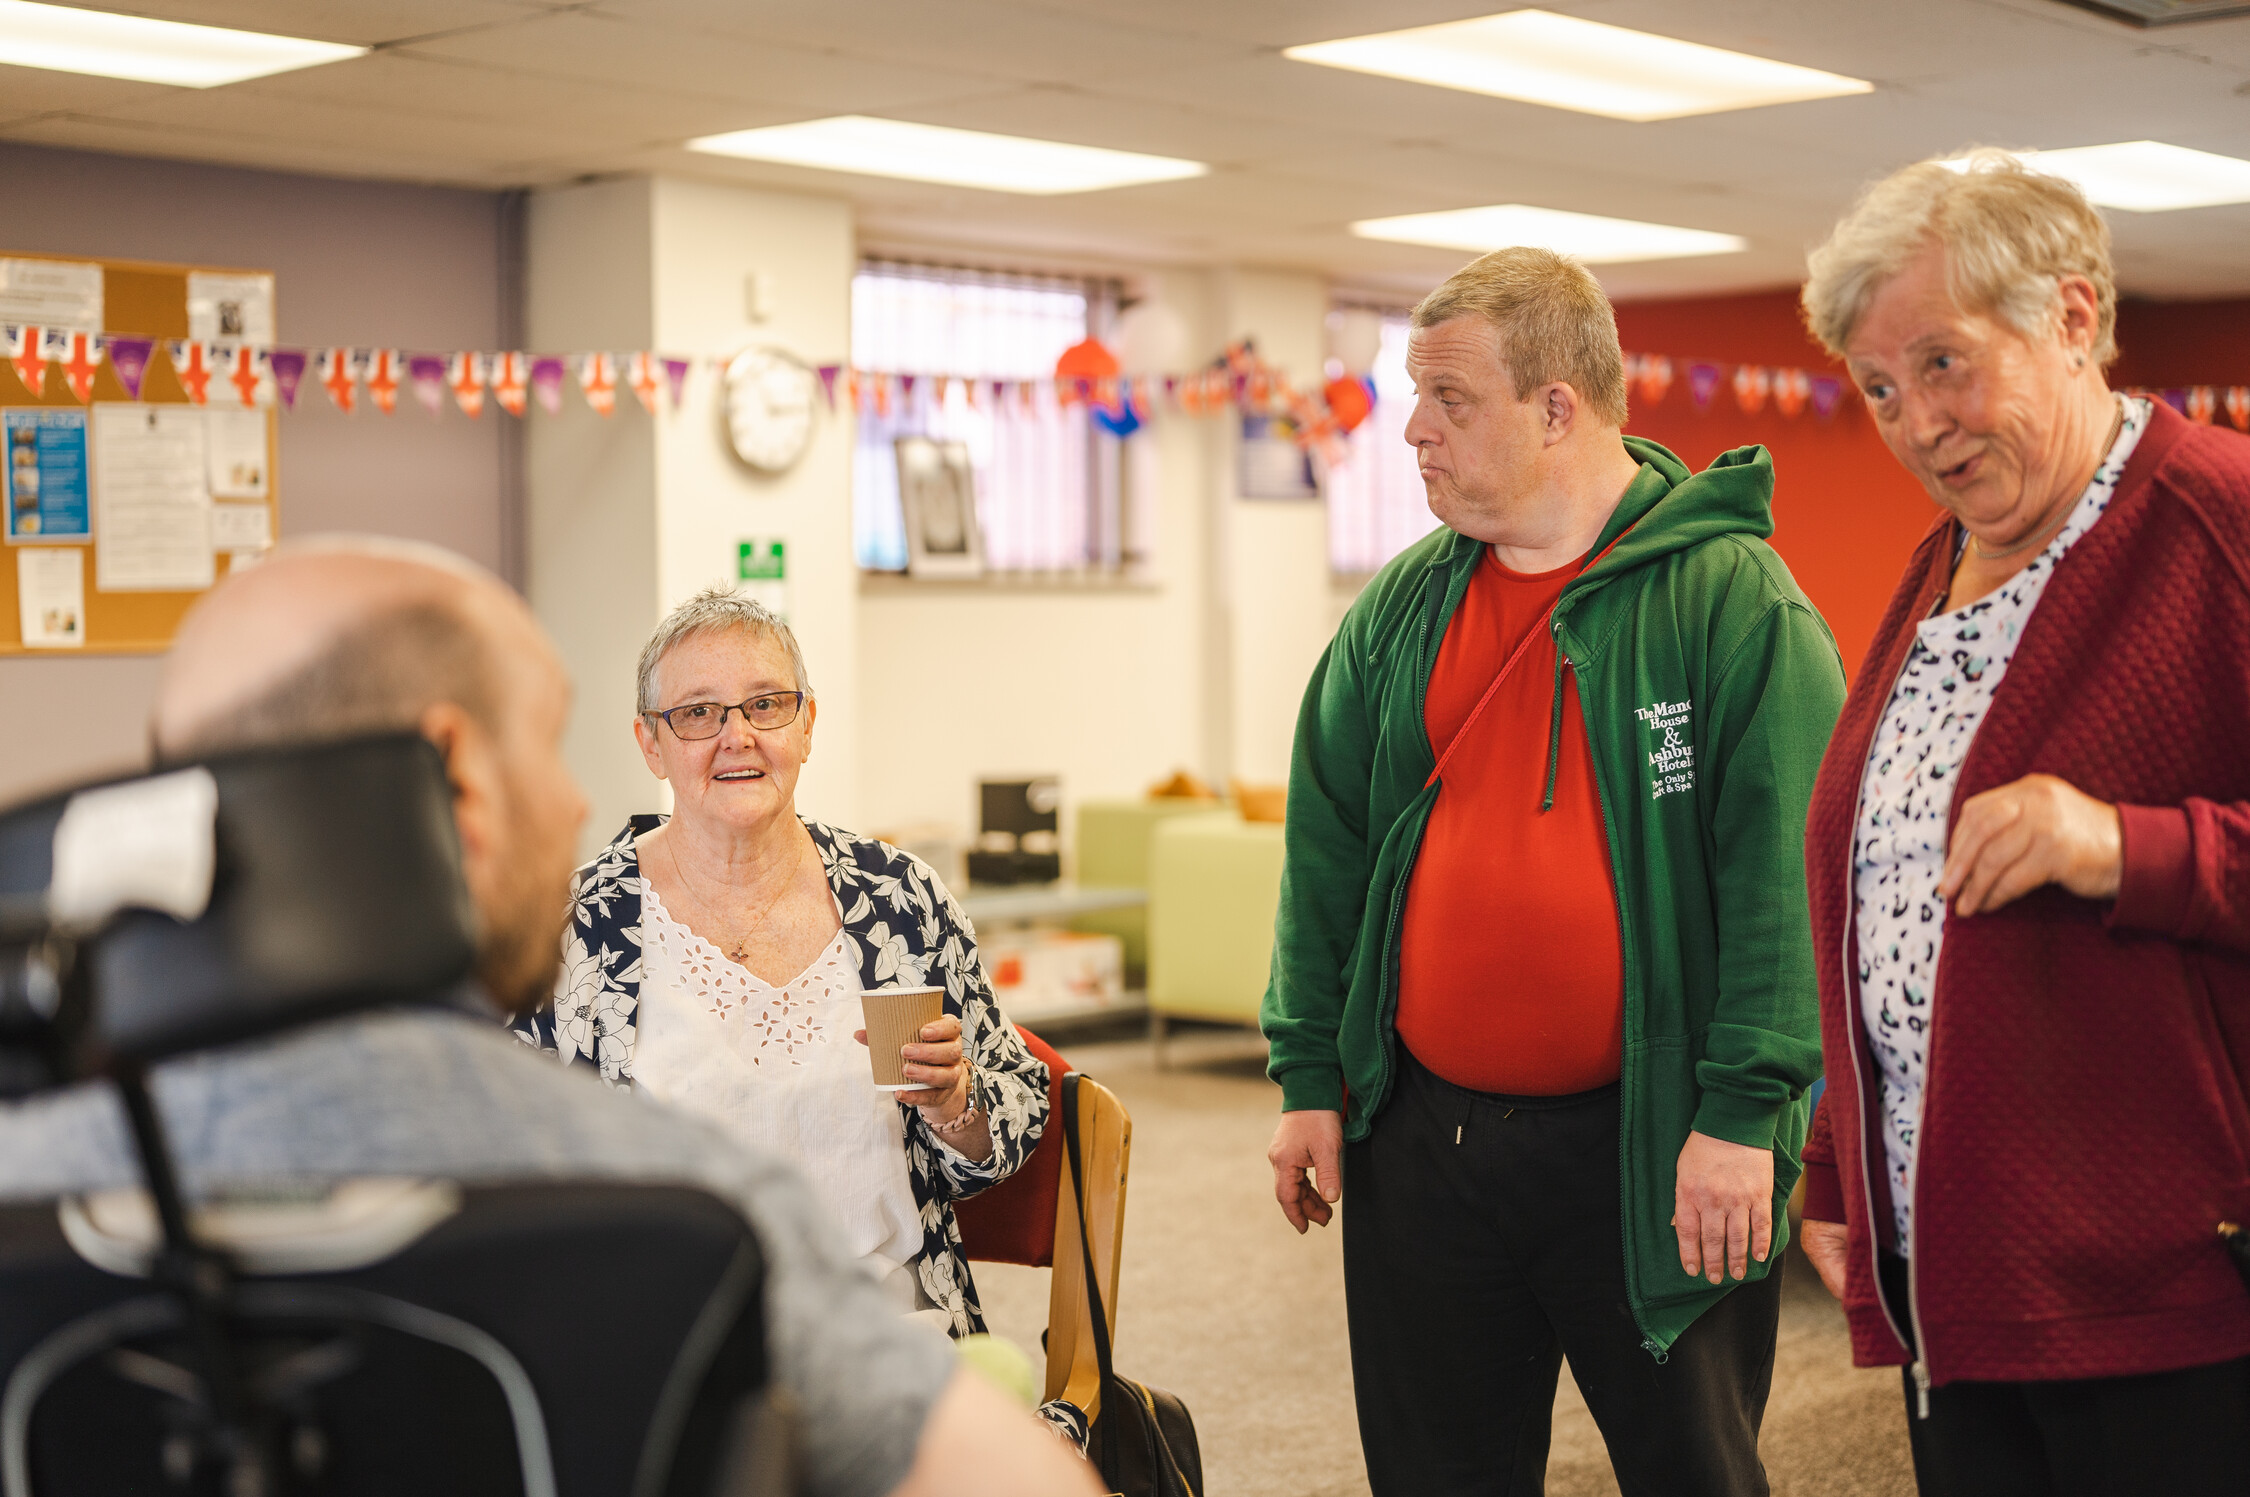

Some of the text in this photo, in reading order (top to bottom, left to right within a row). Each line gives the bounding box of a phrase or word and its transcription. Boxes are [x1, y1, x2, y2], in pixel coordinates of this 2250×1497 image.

[1634, 708, 1654, 720] The
[1650, 715, 1689, 730] House
[1664, 727, 1683, 747] &
[1665, 773, 1686, 784] Only
[1666, 785, 1674, 794] &
[1675, 783, 1692, 793] Spa
